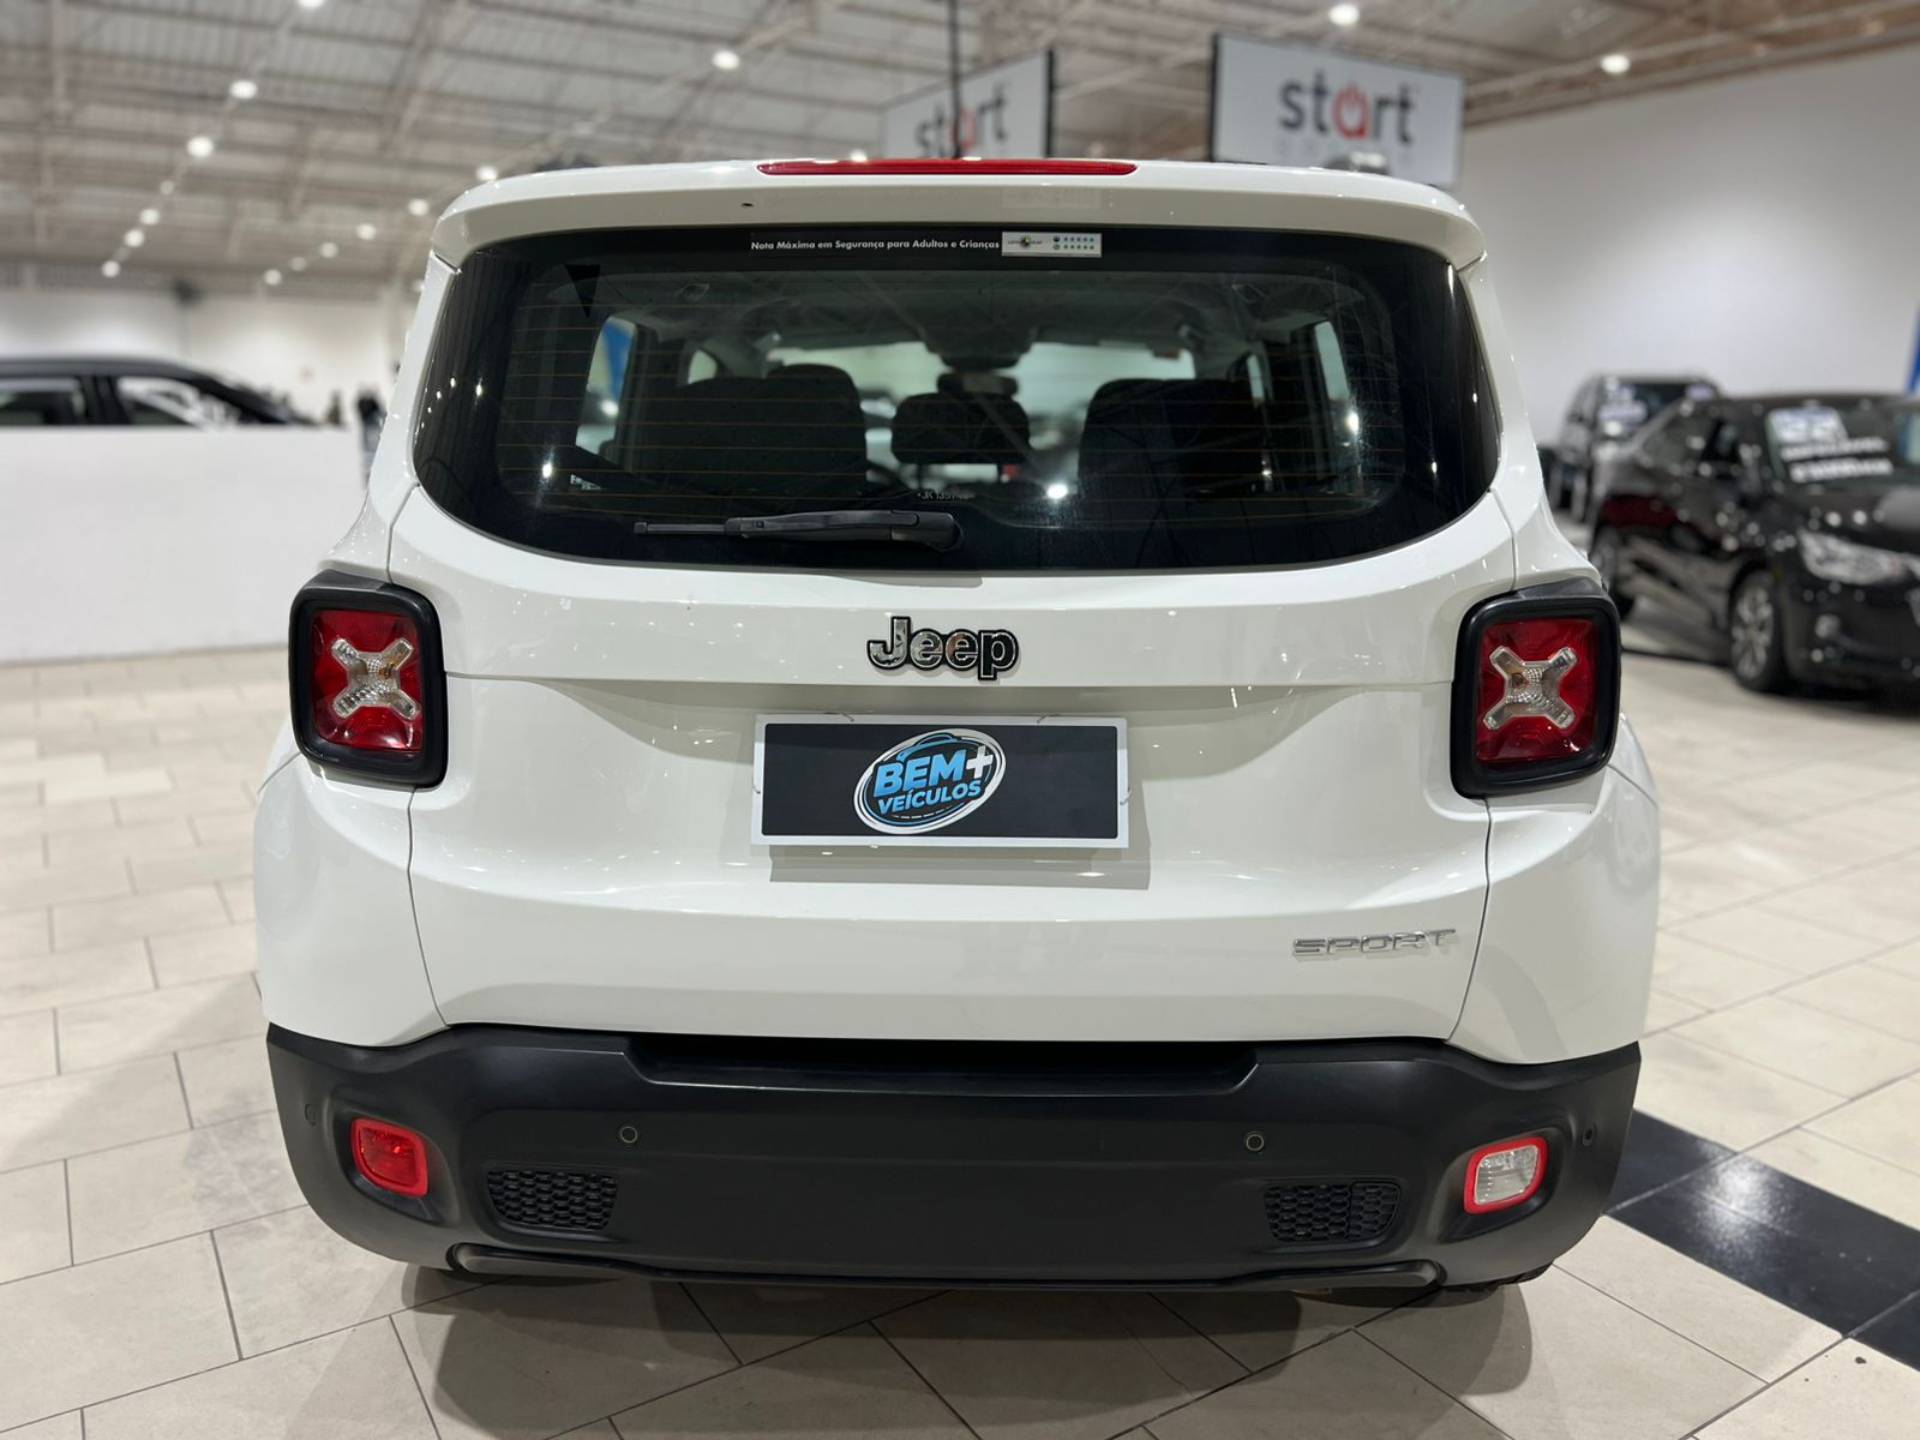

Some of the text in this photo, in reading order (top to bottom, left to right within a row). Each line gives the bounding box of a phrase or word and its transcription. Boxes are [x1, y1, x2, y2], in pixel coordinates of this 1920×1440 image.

[1277, 69, 1412, 146] start
[750, 241, 775, 251] Nota
[776, 240, 816, 250] Máxima
[817, 241, 833, 249] em
[835, 239, 884, 251] Segurança
[887, 240, 910, 251] para
[911, 239, 949, 249] Adultos
[950, 241, 958, 249] e
[959, 239, 1000, 251] Crianças
[866, 616, 1019, 681] Jeep
[877, 779, 981, 816] VEÍCULOS
[1293, 927, 1457, 955] SPORT
